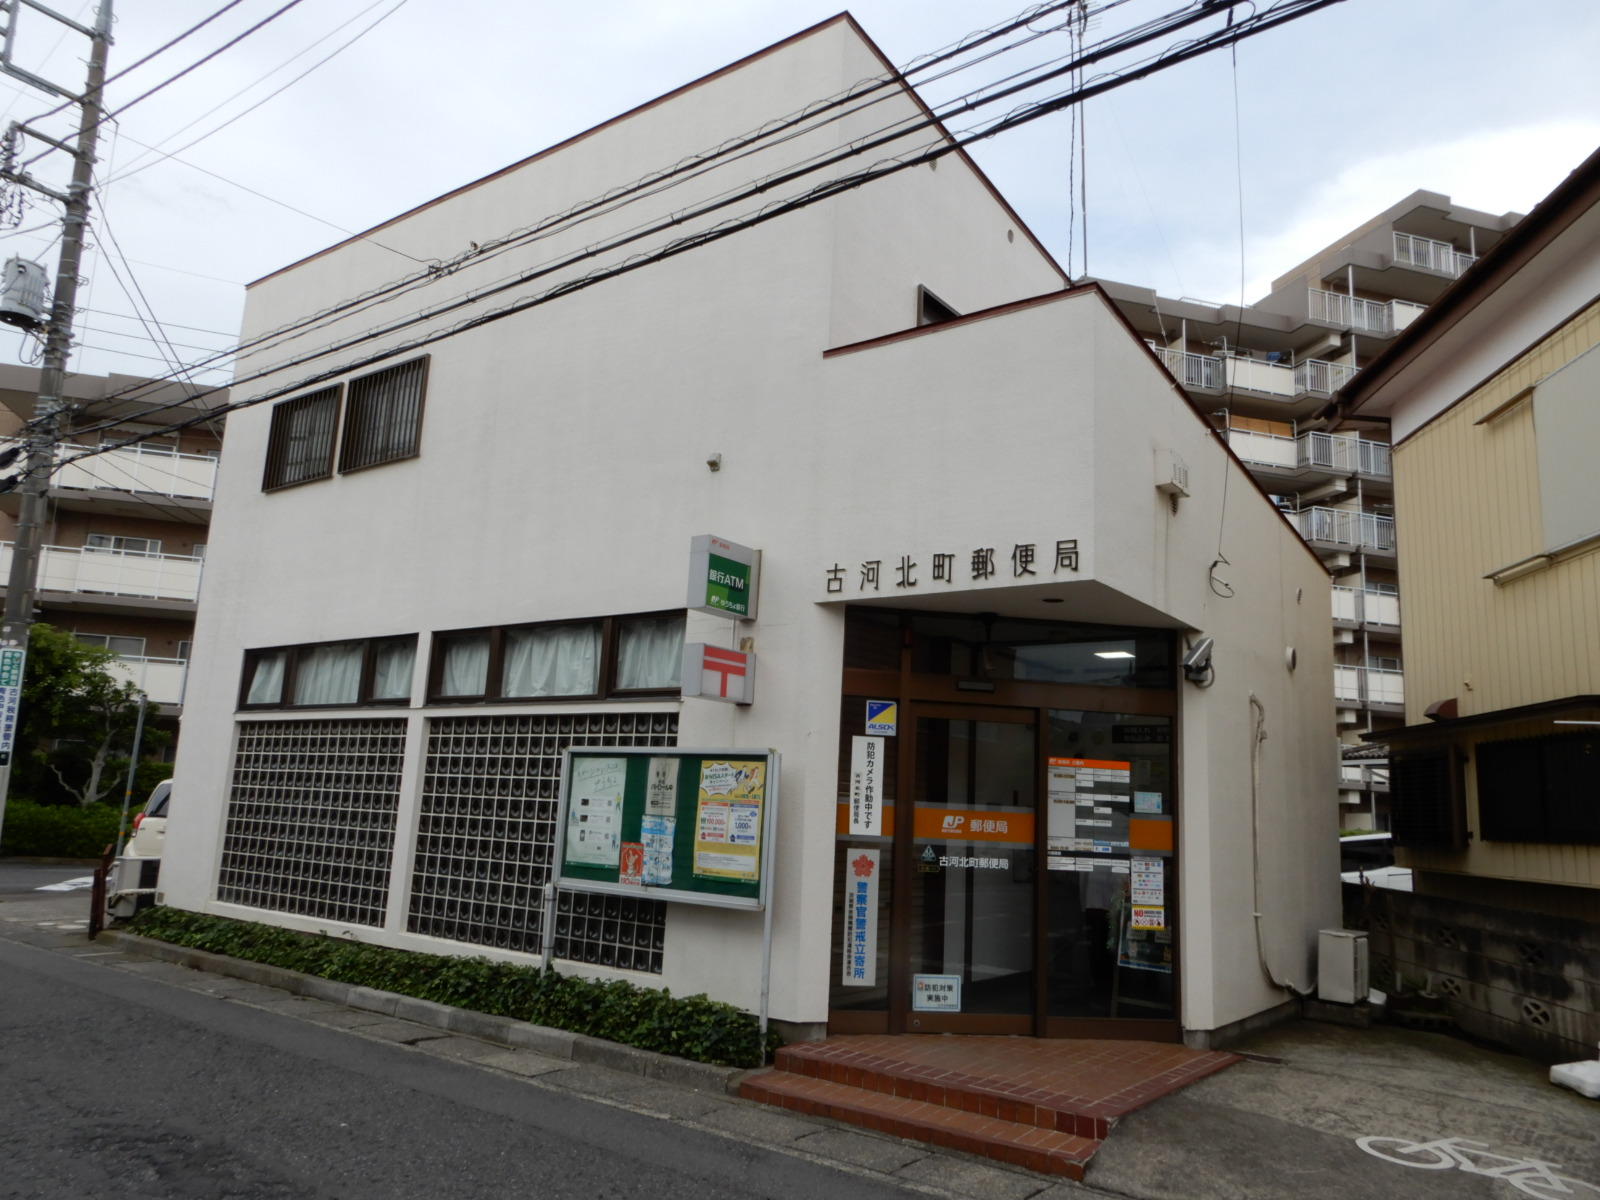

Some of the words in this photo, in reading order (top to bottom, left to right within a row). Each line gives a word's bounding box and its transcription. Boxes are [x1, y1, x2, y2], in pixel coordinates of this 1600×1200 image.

[826, 539, 1079, 594] 古河北町郵便局
[709, 569, 744, 590] 銀行ATM
[720, 600, 745, 612] ゆうちょ銀行
[1, 687, 18, 750] 古河税務署管内
[868, 723, 895, 731] ALSOK
[864, 742, 875, 829] 防犯カメラ作動中です
[970, 819, 1008, 834] 郵便局
[939, 856, 1009, 869] 古河北町郵便局
[1134, 909, 1143, 917] NO
[853, 881, 868, 980] 警察官警戒立寄所
[925, 983, 954, 992] 防犯対策
[926, 994, 949, 1003] 実施中
